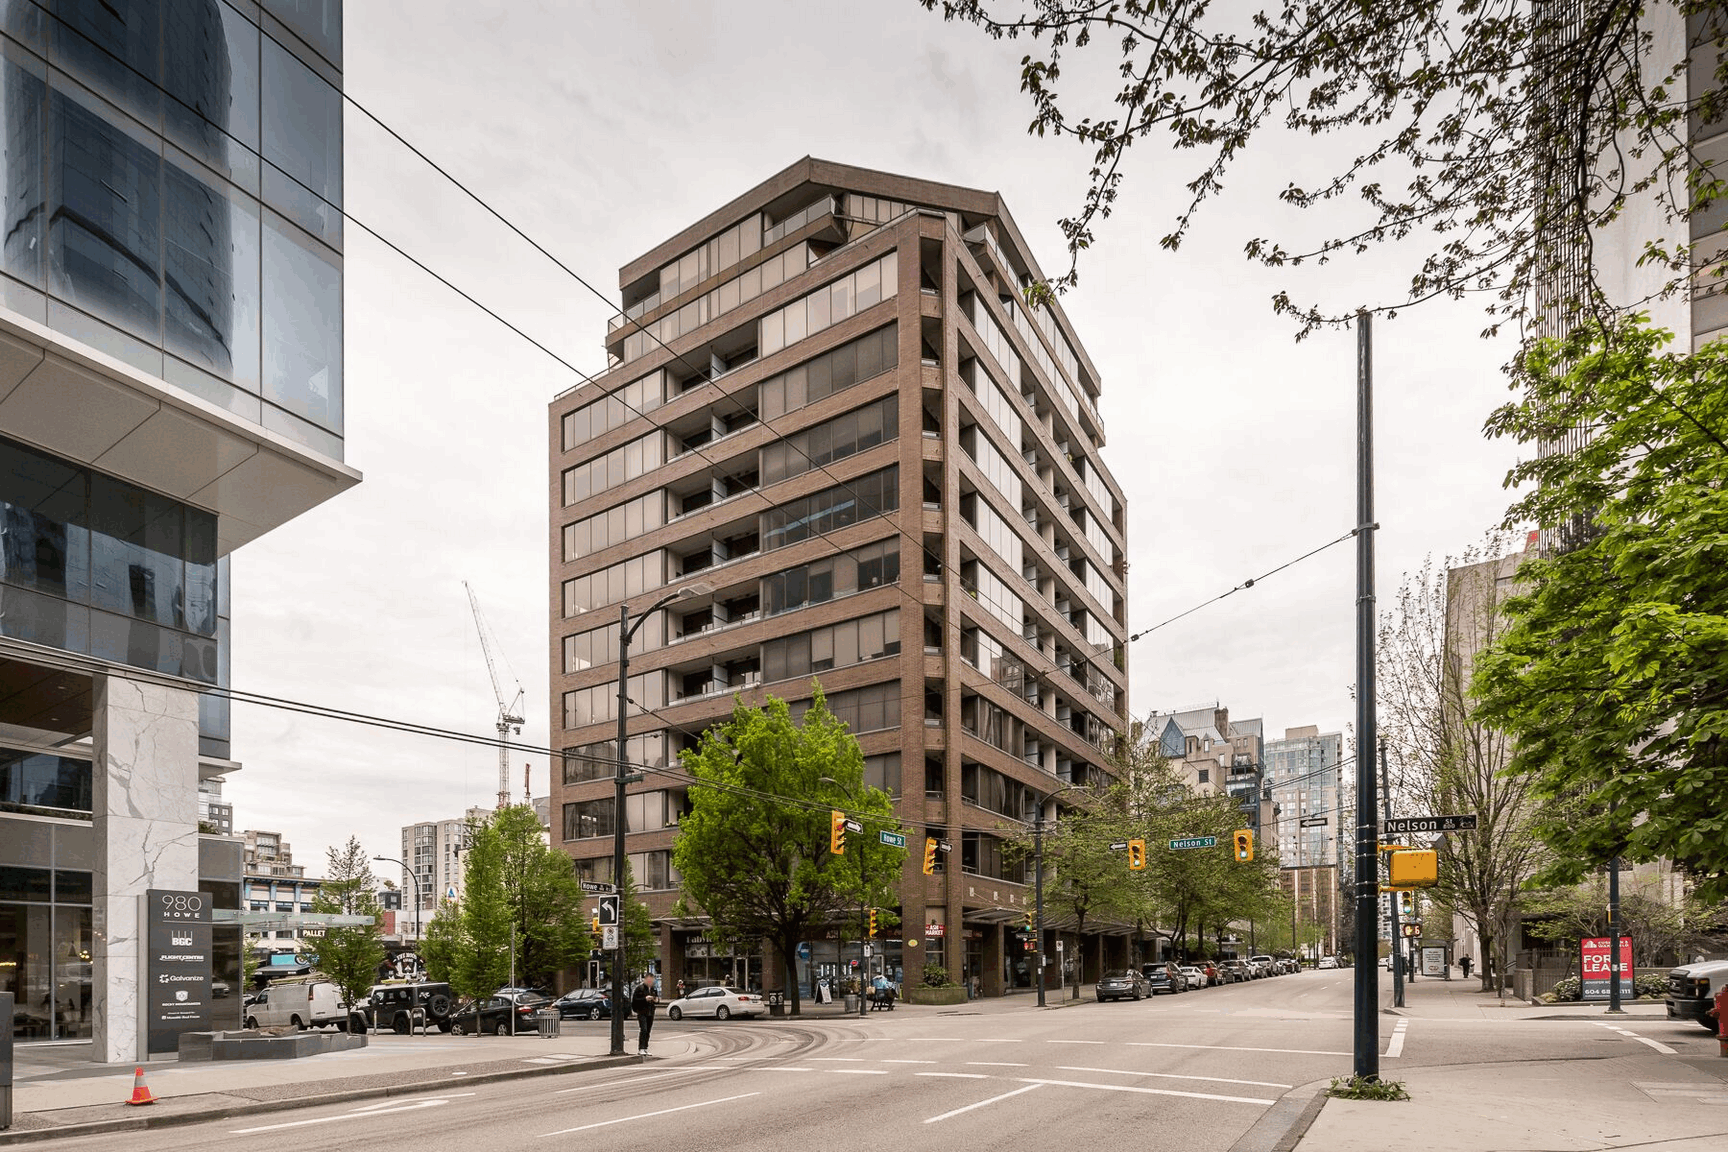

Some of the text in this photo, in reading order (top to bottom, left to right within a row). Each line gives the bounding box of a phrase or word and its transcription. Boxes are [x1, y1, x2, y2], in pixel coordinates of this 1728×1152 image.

[1387, 820, 1437, 832] Nelson
[582, 882, 598, 891] Howe
[162, 895, 202, 911] 980
[302, 929, 326, 937] PALLET
[171, 937, 193, 946] BGC
[1584, 954, 1610, 964] FOR
[1584, 963, 1628, 972] LEAE
